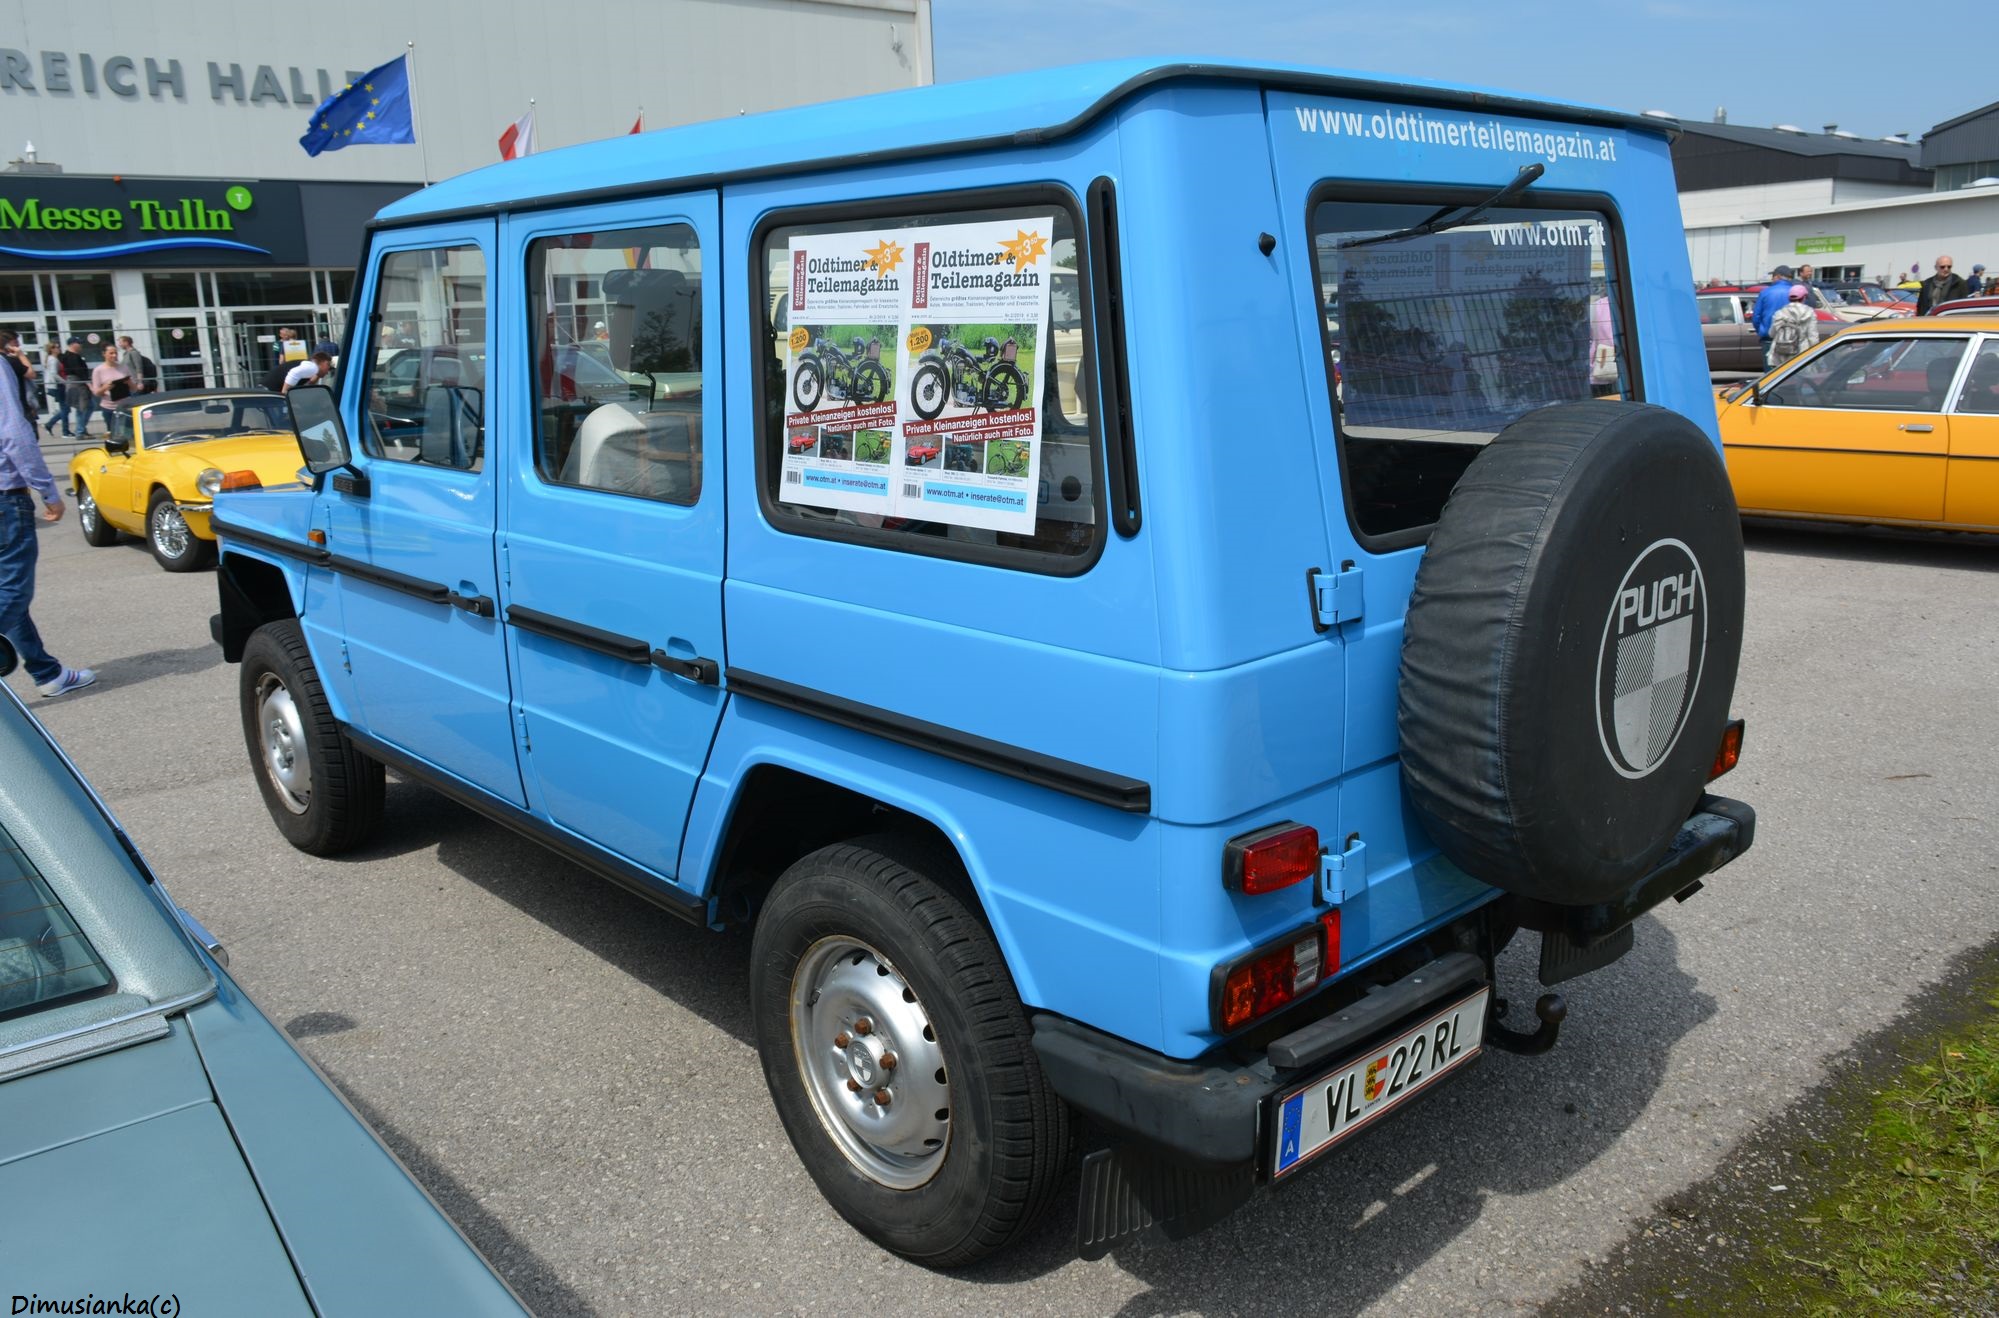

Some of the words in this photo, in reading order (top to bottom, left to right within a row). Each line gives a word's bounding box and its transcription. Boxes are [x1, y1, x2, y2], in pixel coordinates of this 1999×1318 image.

[208, 61, 366, 105] HALL
[1296, 107, 1617, 163] www.oldtimerteilemagazin.at
[0, 198, 122, 231] Messe
[130, 198, 234, 231] Tulln
[1490, 221, 1607, 247] www.otm.at
[808, 257, 867, 274] Oldtimer
[870, 261, 878, 272] &
[932, 249, 1003, 269] Oldtimer
[1006, 253, 1016, 265] &
[808, 274, 899, 296] Teilemagazin
[931, 269, 1040, 292] Teilemagazin
[910, 335, 929, 347] 1.200
[788, 416, 809, 426] Private
[811, 410, 856, 423] Kleinanzeigen
[857, 405, 895, 417] kostenlos!
[827, 423, 852, 433] Natürlich
[853, 421, 867, 430] auch
[867, 420, 878, 428] mit
[878, 418, 895, 427] Foto.
[906, 424, 931, 435] Private
[933, 418, 987, 432] Kleinanzeigen
[989, 410, 1033, 425] kostenlos!
[953, 431, 983, 443] Natürlich
[984, 430, 1000, 440] auch
[1001, 428, 1014, 437] mit
[1015, 426, 1034, 437] Foto.
[806, 475, 837, 485] www.otm.at
[926, 488, 964, 499] www.otm.at
[970, 492, 1024, 506] inserate@otm.at
[1618, 569, 1697, 635] PUCH
[1325, 1073, 1361, 1133] VL
[1386, 1034, 1427, 1098] 22
[1430, 1012, 1462, 1071] RL
[1285, 1139, 1294, 1157] A
